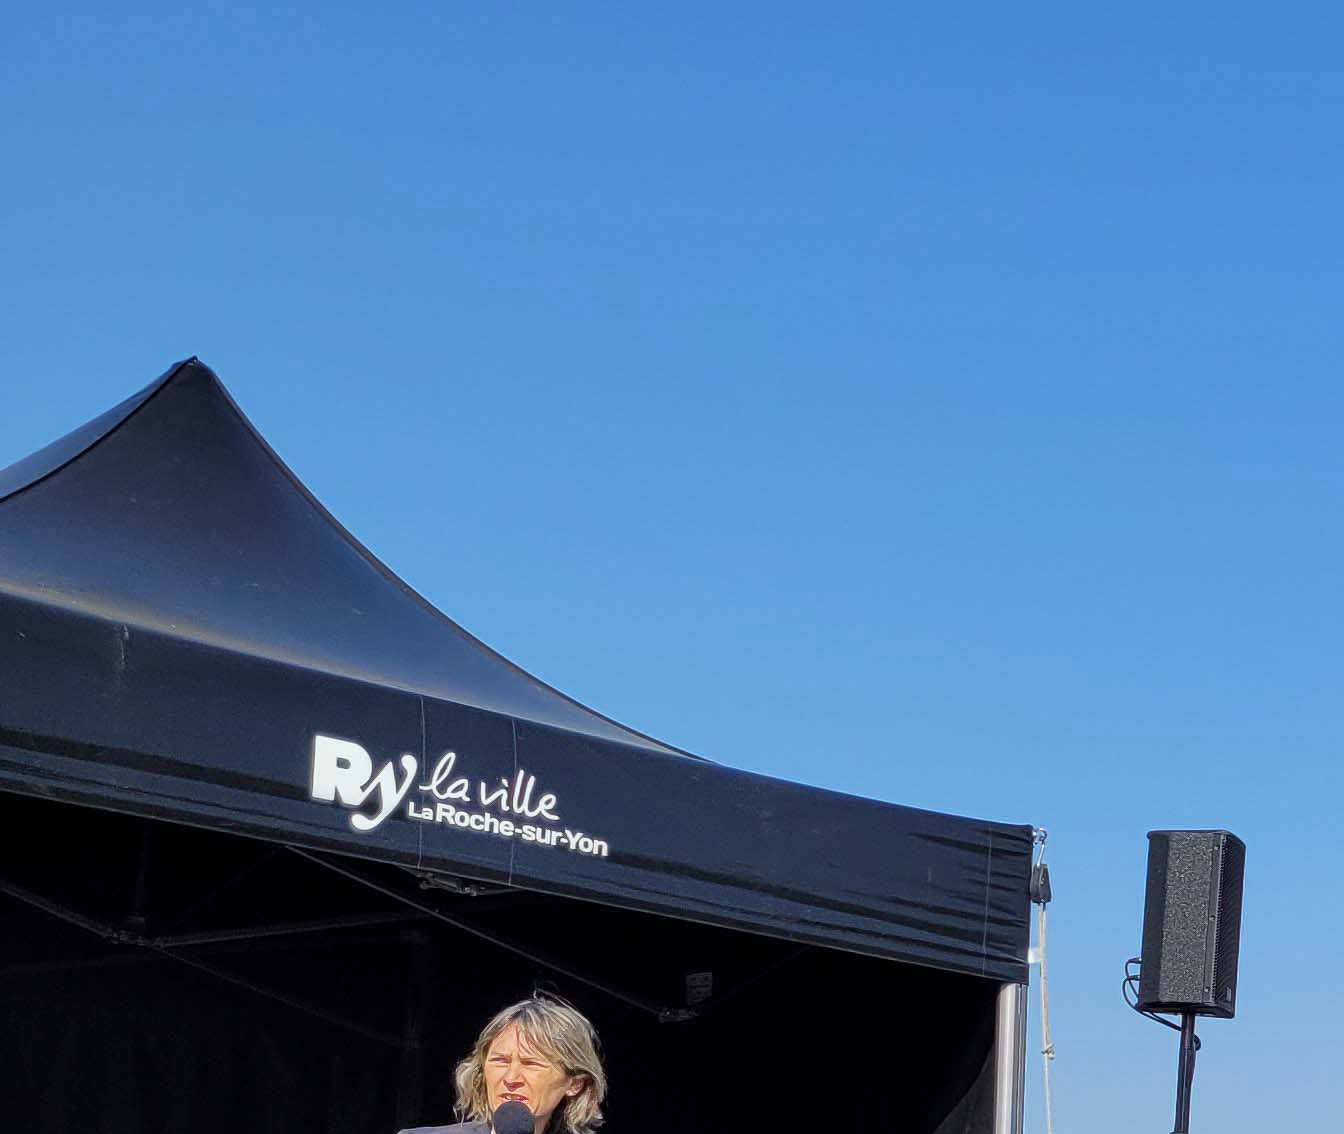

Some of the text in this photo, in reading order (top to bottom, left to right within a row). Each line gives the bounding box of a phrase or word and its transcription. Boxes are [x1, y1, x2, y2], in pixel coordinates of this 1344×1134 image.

[419, 752, 560, 821] la ville
[409, 801, 609, 857] La Roche-sur-Yon
